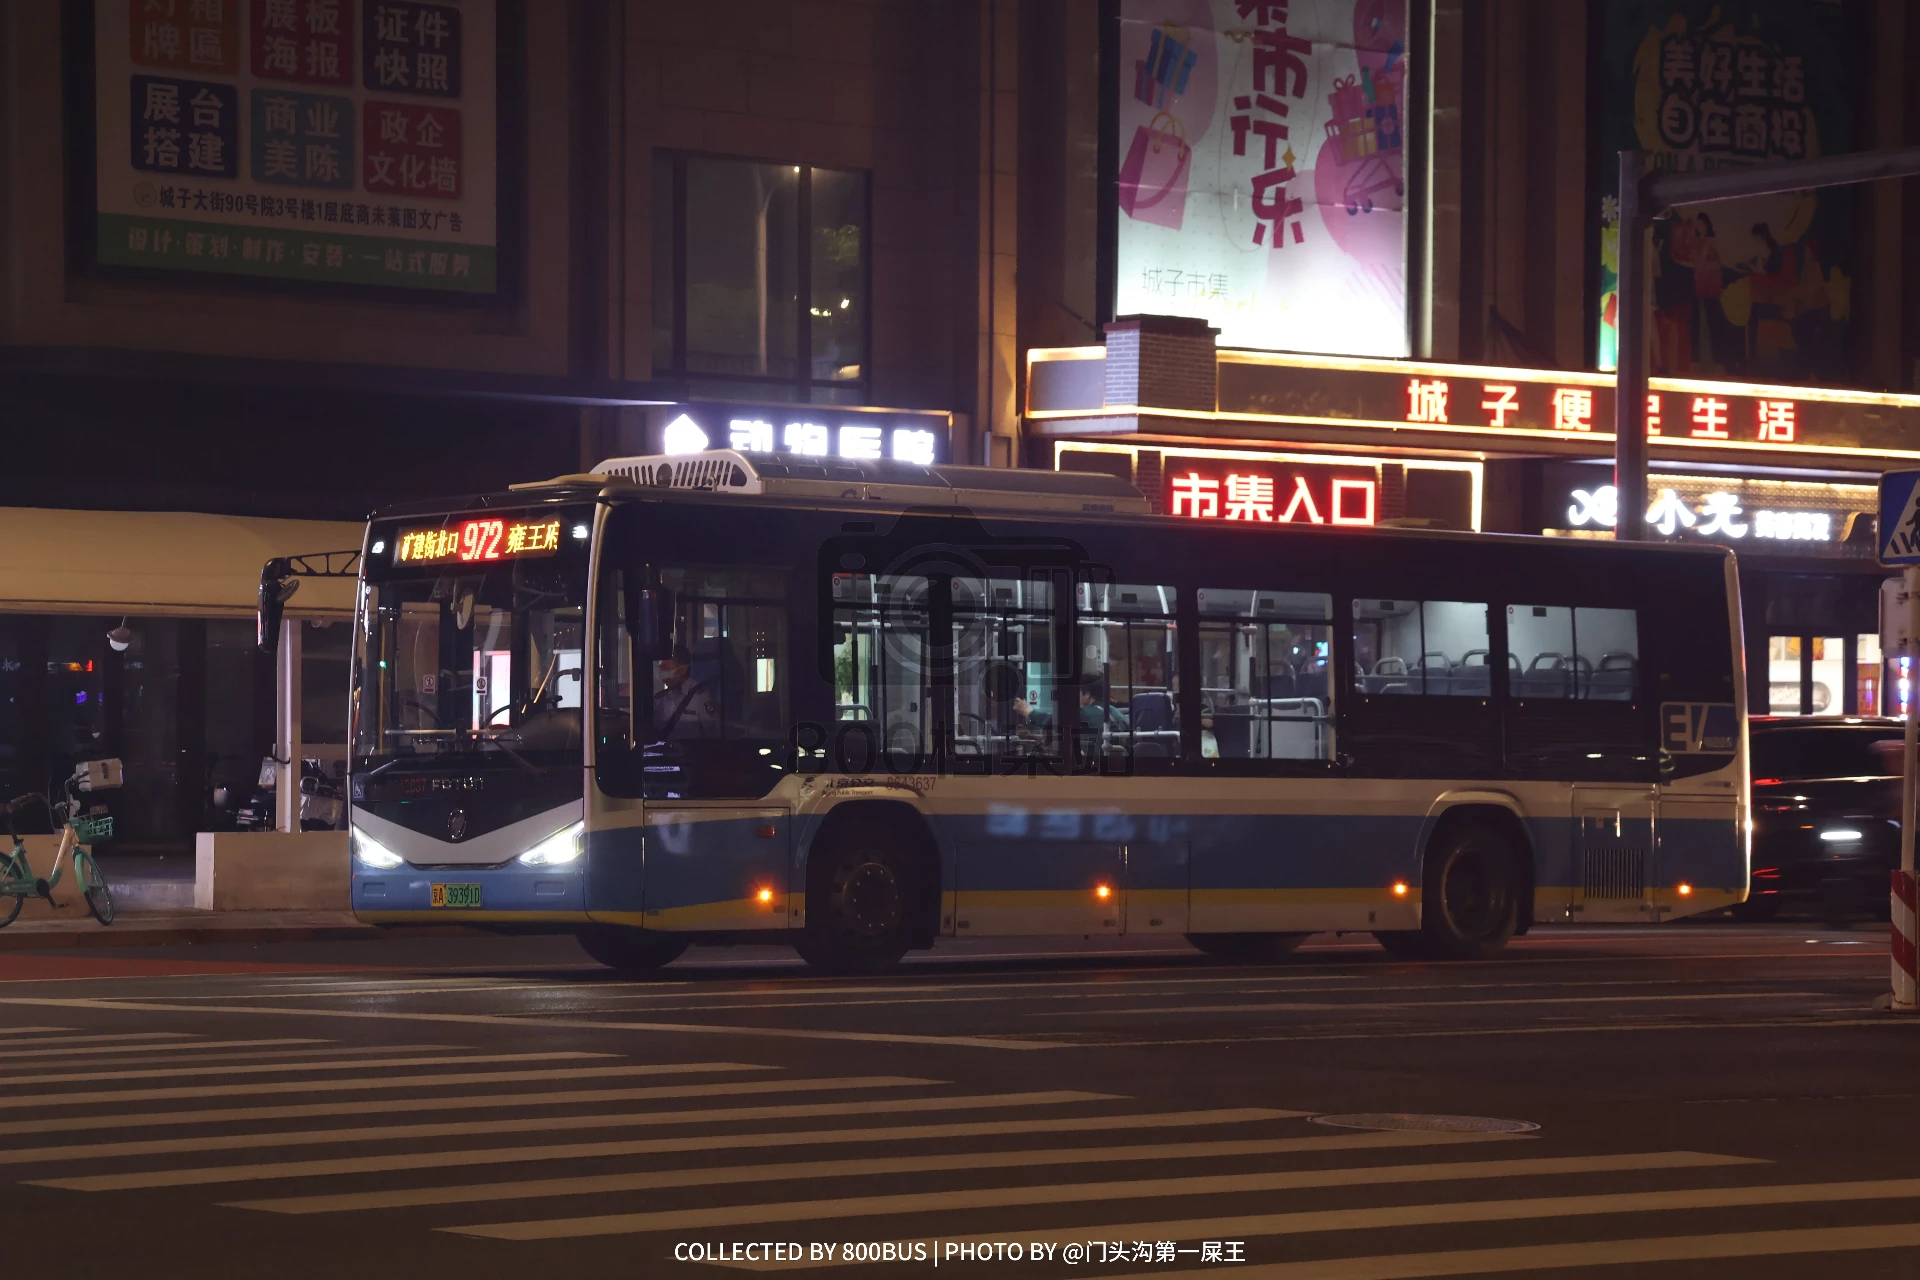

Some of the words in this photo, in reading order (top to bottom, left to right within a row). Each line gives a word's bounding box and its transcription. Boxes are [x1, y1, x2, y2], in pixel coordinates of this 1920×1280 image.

[374, 5, 449, 49] 证件
[262, 35, 341, 79] 海报
[374, 46, 450, 91] 快照
[1662, 38, 1805, 103] 美好生活
[143, 82, 225, 128] 展台
[263, 96, 341, 138] 商业
[143, 126, 226, 171] 搭建
[380, 109, 444, 148] 政企
[263, 138, 341, 183] 美陈
[368, 150, 458, 193] 文化墙
[1141, 266, 1229, 301] 城子市集
[1171, 472, 1376, 526] 市集入口
[461, 519, 504, 561] 972
